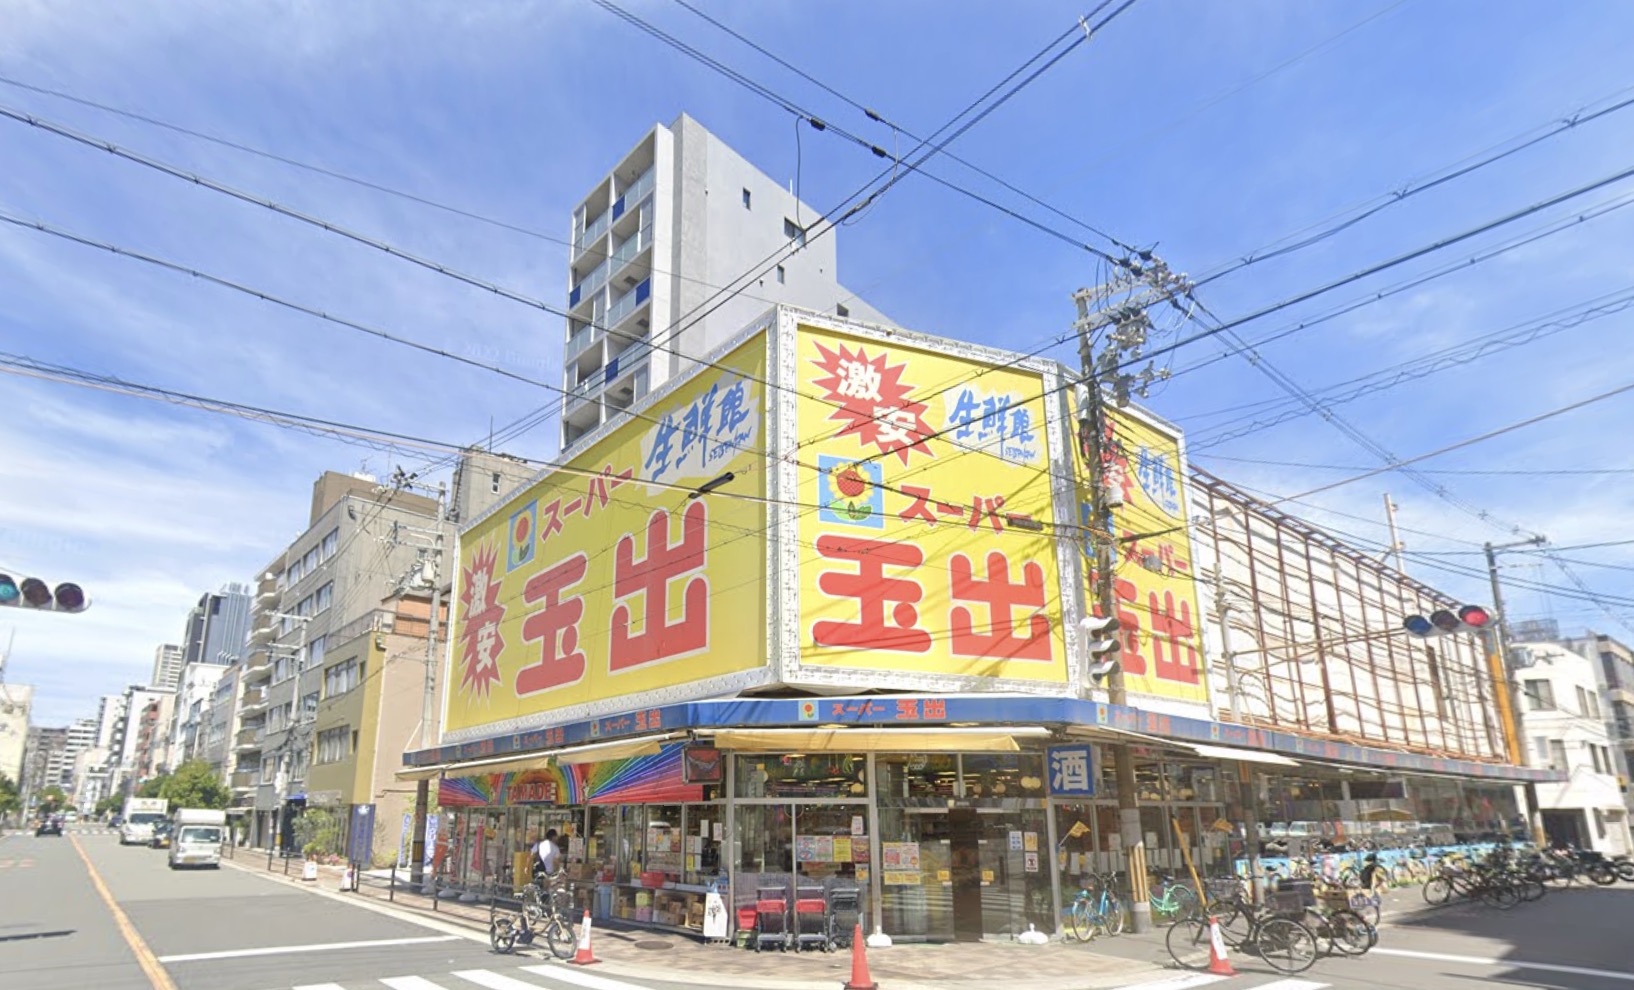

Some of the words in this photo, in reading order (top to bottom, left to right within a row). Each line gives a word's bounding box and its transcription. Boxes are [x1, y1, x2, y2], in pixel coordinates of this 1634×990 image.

[645, 381, 750, 482] 生鮮館
[837, 357, 917, 444] 激安
[949, 389, 1034, 459] 生鮮館
[541, 464, 634, 542] スーパー
[899, 485, 1040, 536] スーパー
[514, 498, 710, 699] 玉出
[811, 533, 1054, 663] 玉出
[832, 702, 885, 717] スーパー
[896, 699, 946, 720] 玉出
[1051, 750, 1090, 791] 酒
